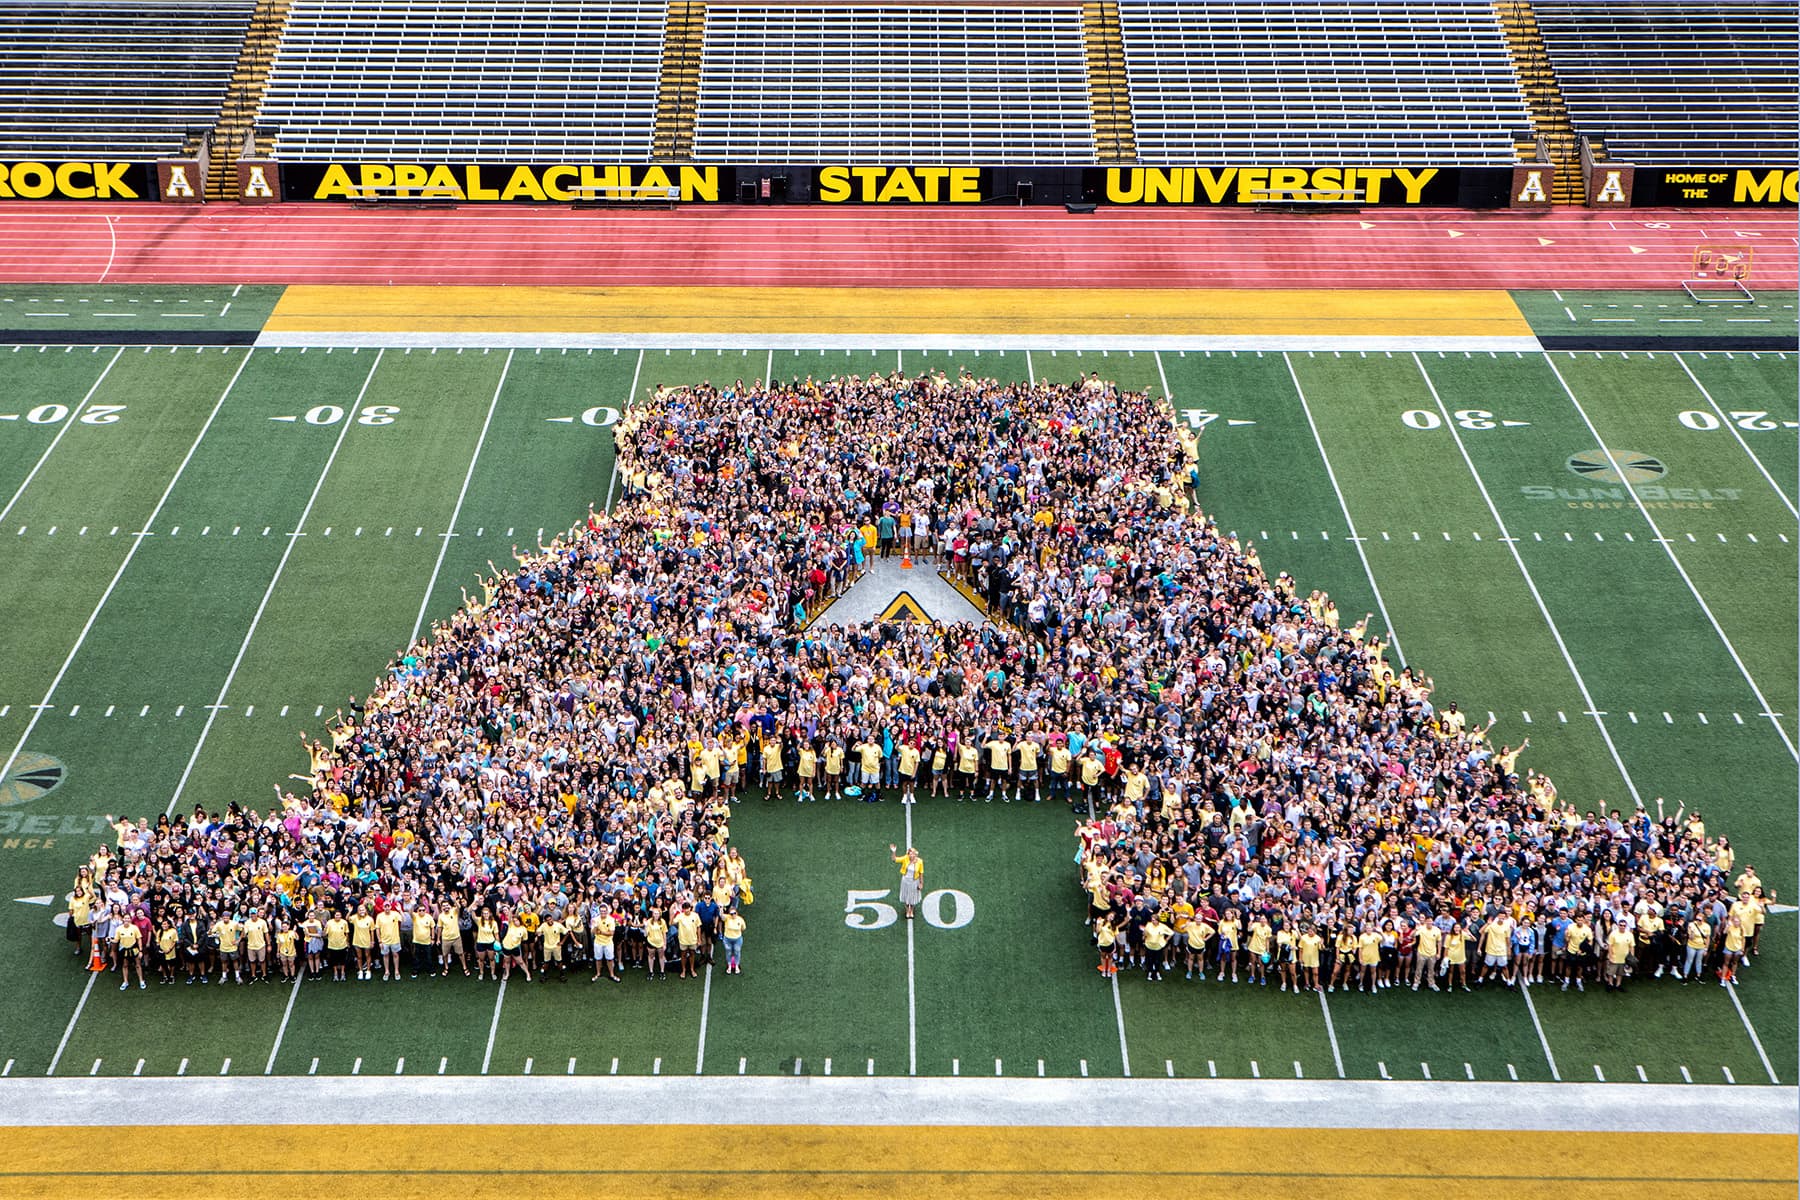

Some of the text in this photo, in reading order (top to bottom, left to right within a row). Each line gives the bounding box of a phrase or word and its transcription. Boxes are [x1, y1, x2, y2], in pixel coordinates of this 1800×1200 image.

[166, 165, 195, 197] A
[245, 165, 274, 197] A
[313, 164, 1439, 203] APPALACHIAN STATE UNIVERSITY
[1517, 170, 1547, 202] A
[1597, 170, 1626, 202] A
[1665, 173, 1729, 183] HOME OF
[1682, 188, 1709, 199] THE
[844, 888, 976, 930] 50
